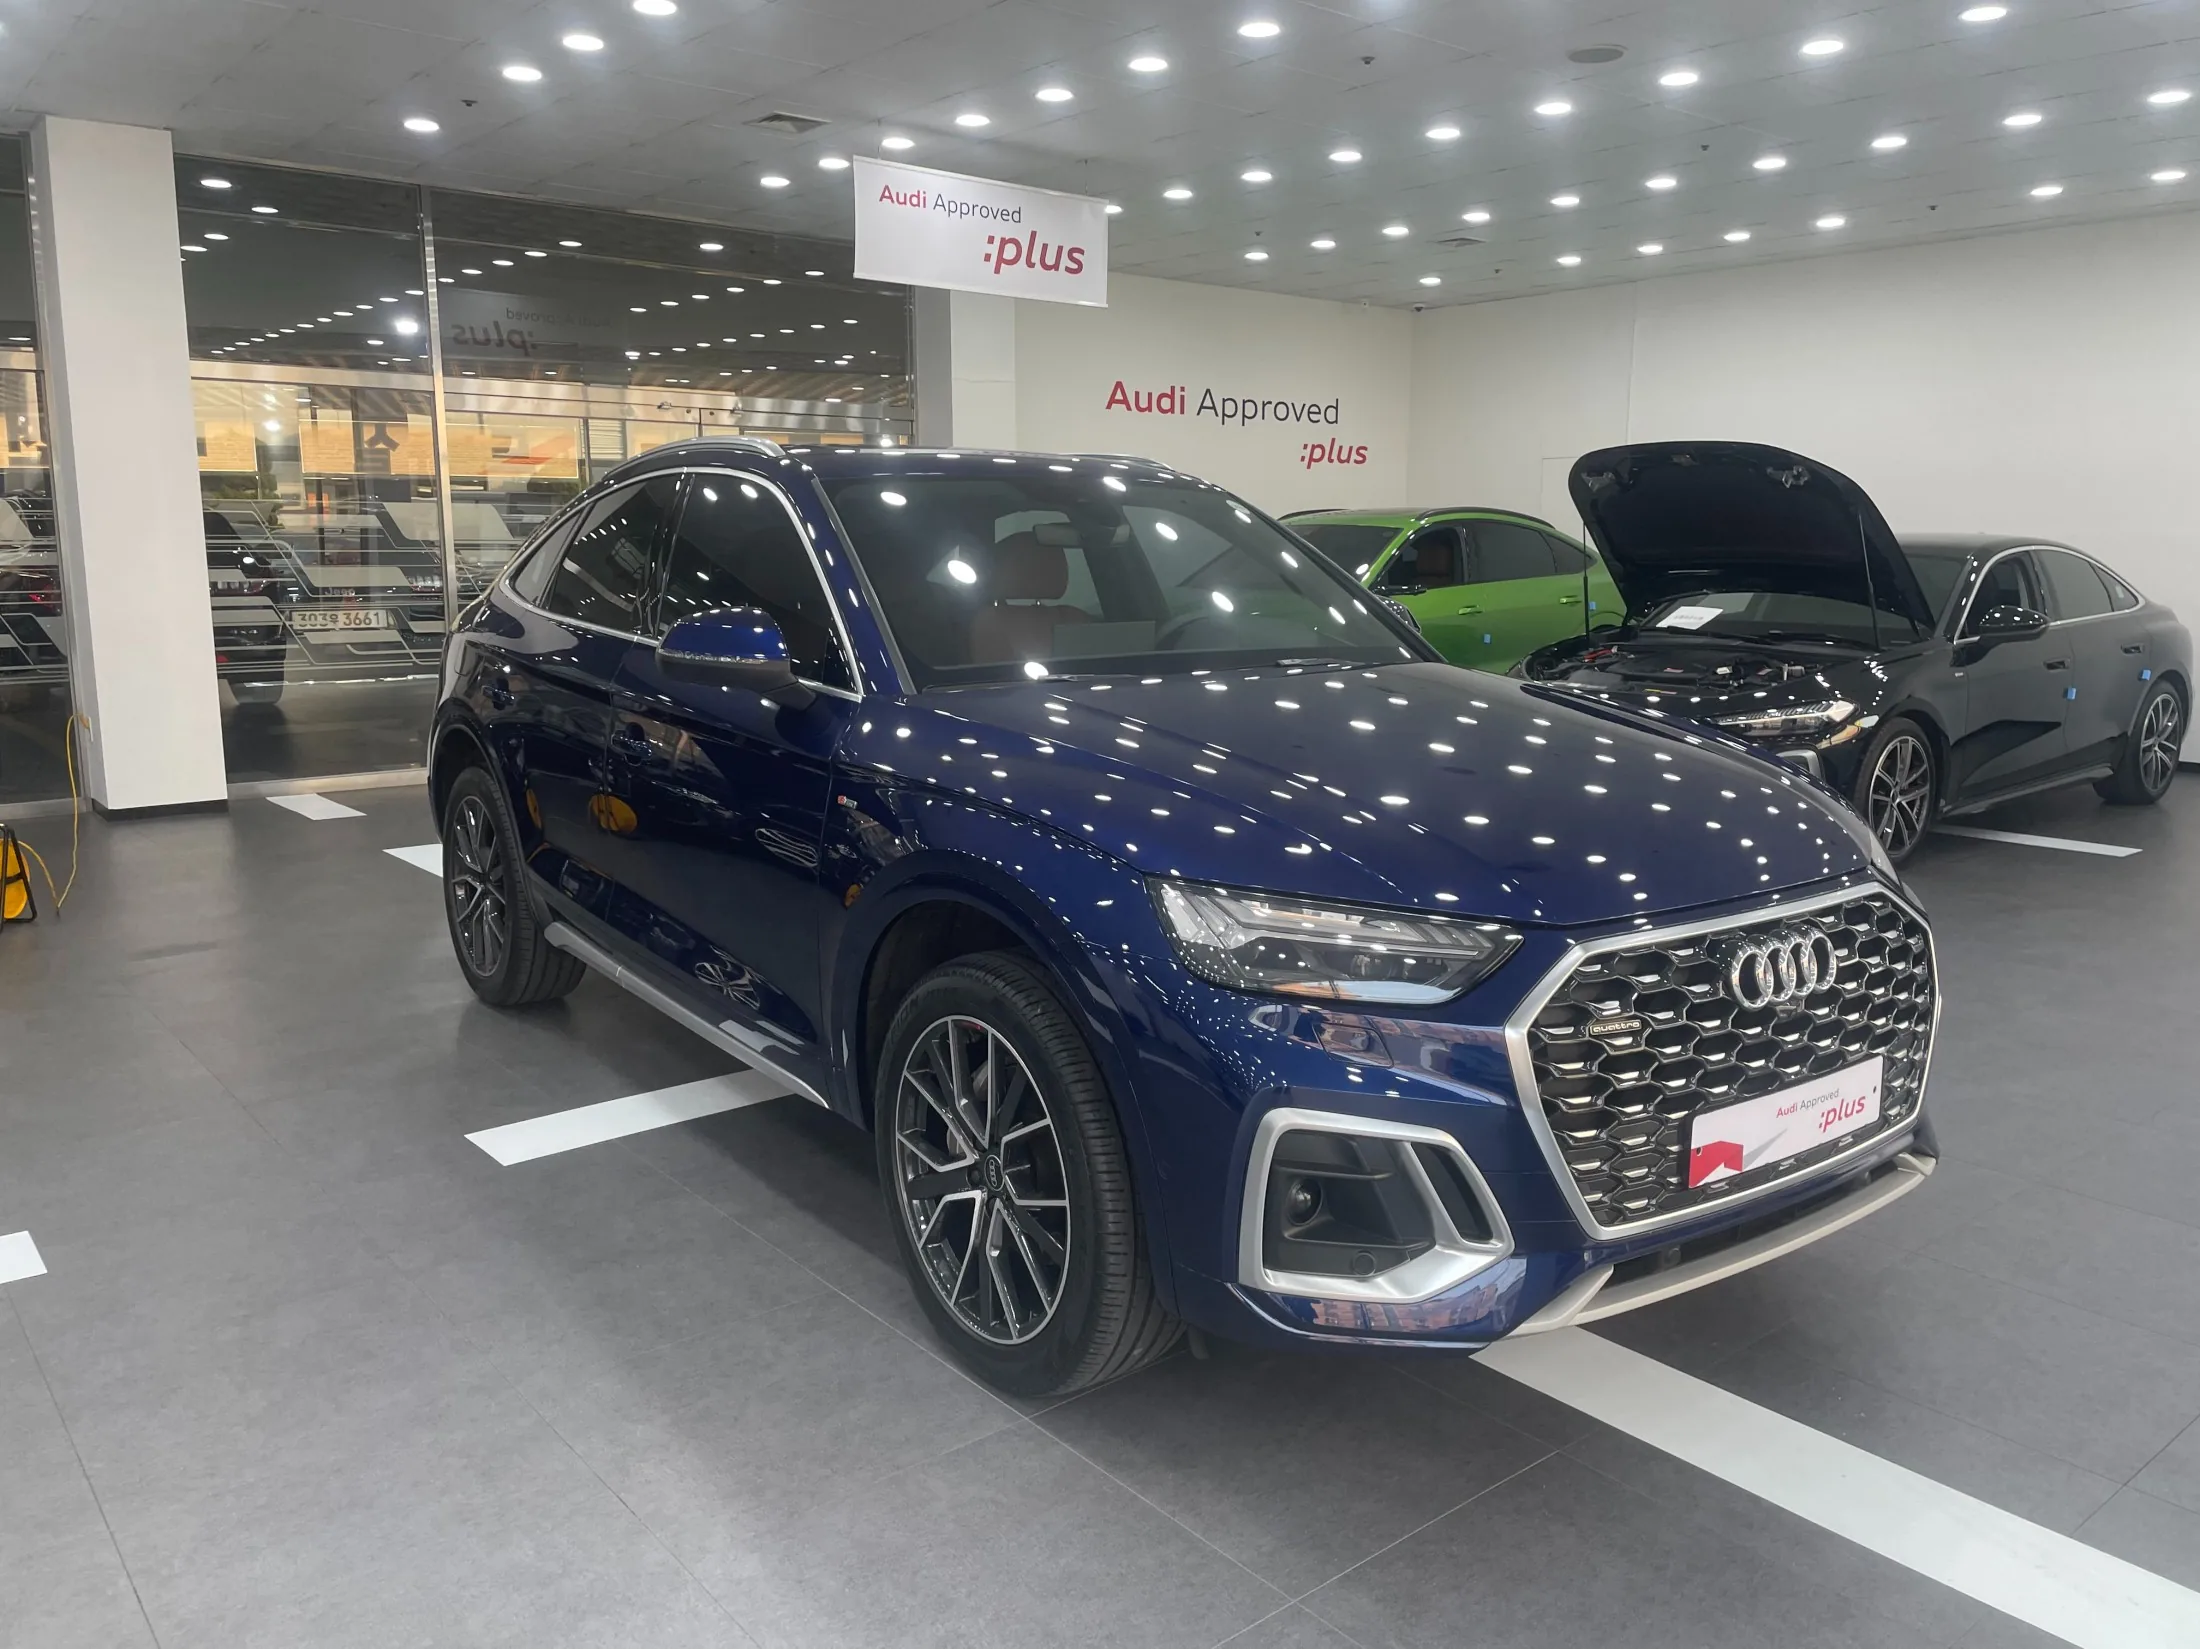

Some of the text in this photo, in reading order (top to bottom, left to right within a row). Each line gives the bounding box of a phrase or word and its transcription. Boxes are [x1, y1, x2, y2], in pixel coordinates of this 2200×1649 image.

[879, 185, 1022, 223] Audi Approved
[983, 231, 1084, 275] :plus
[1105, 381, 1339, 426] Audi Approved
[1300, 438, 1368, 469] :plus
[343, 611, 379, 627] 3661
[1593, 1021, 1640, 1033] quattro
[1776, 1088, 1840, 1118] Audi Approved
[1818, 1095, 1866, 1133] :plus
